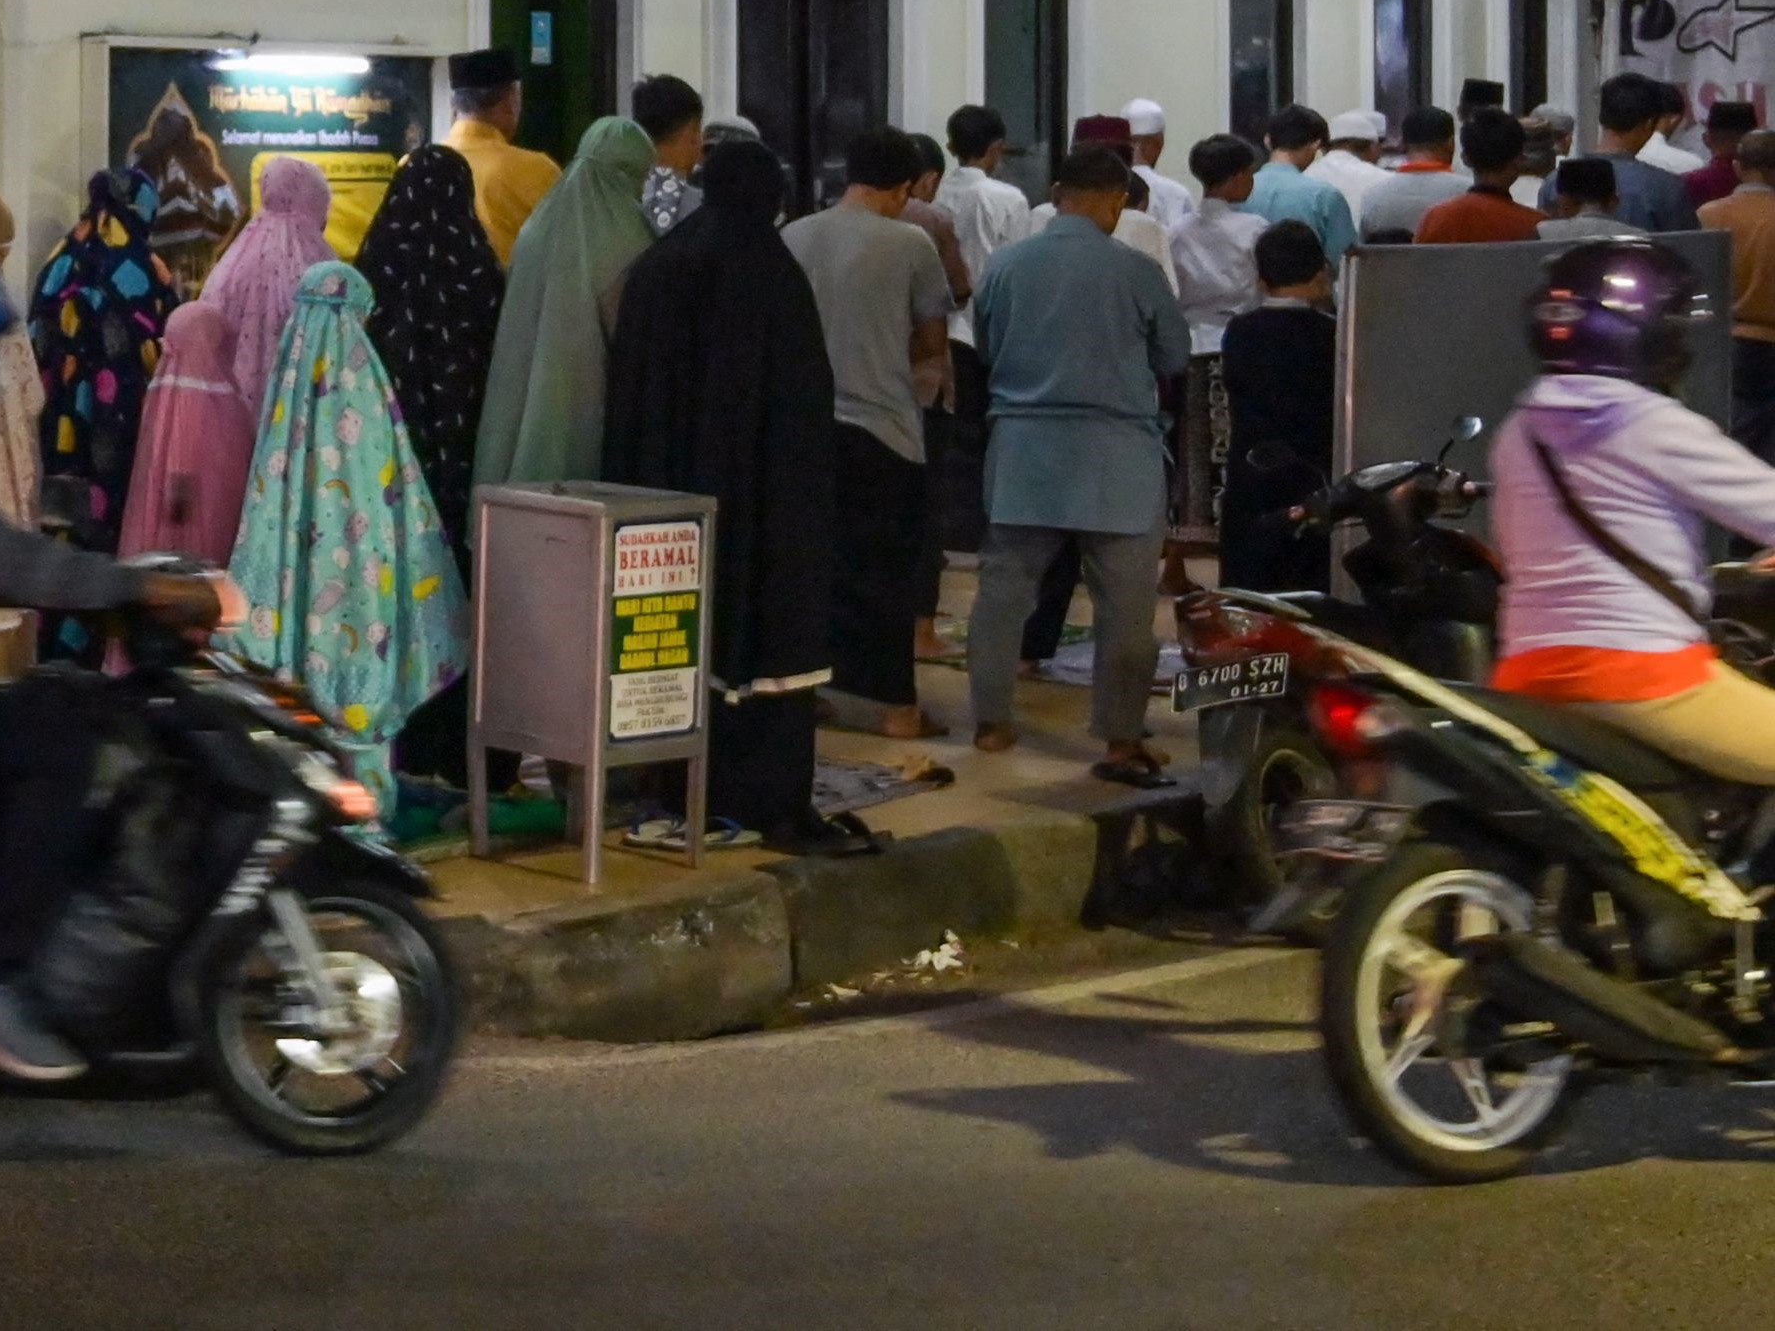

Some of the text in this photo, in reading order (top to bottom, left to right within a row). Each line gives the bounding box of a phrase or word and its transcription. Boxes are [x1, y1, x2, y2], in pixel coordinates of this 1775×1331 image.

[619, 546, 695, 570] BERAMAL
[1197, 664, 1241, 687] 6700
[1249, 656, 1285, 678] SZH
